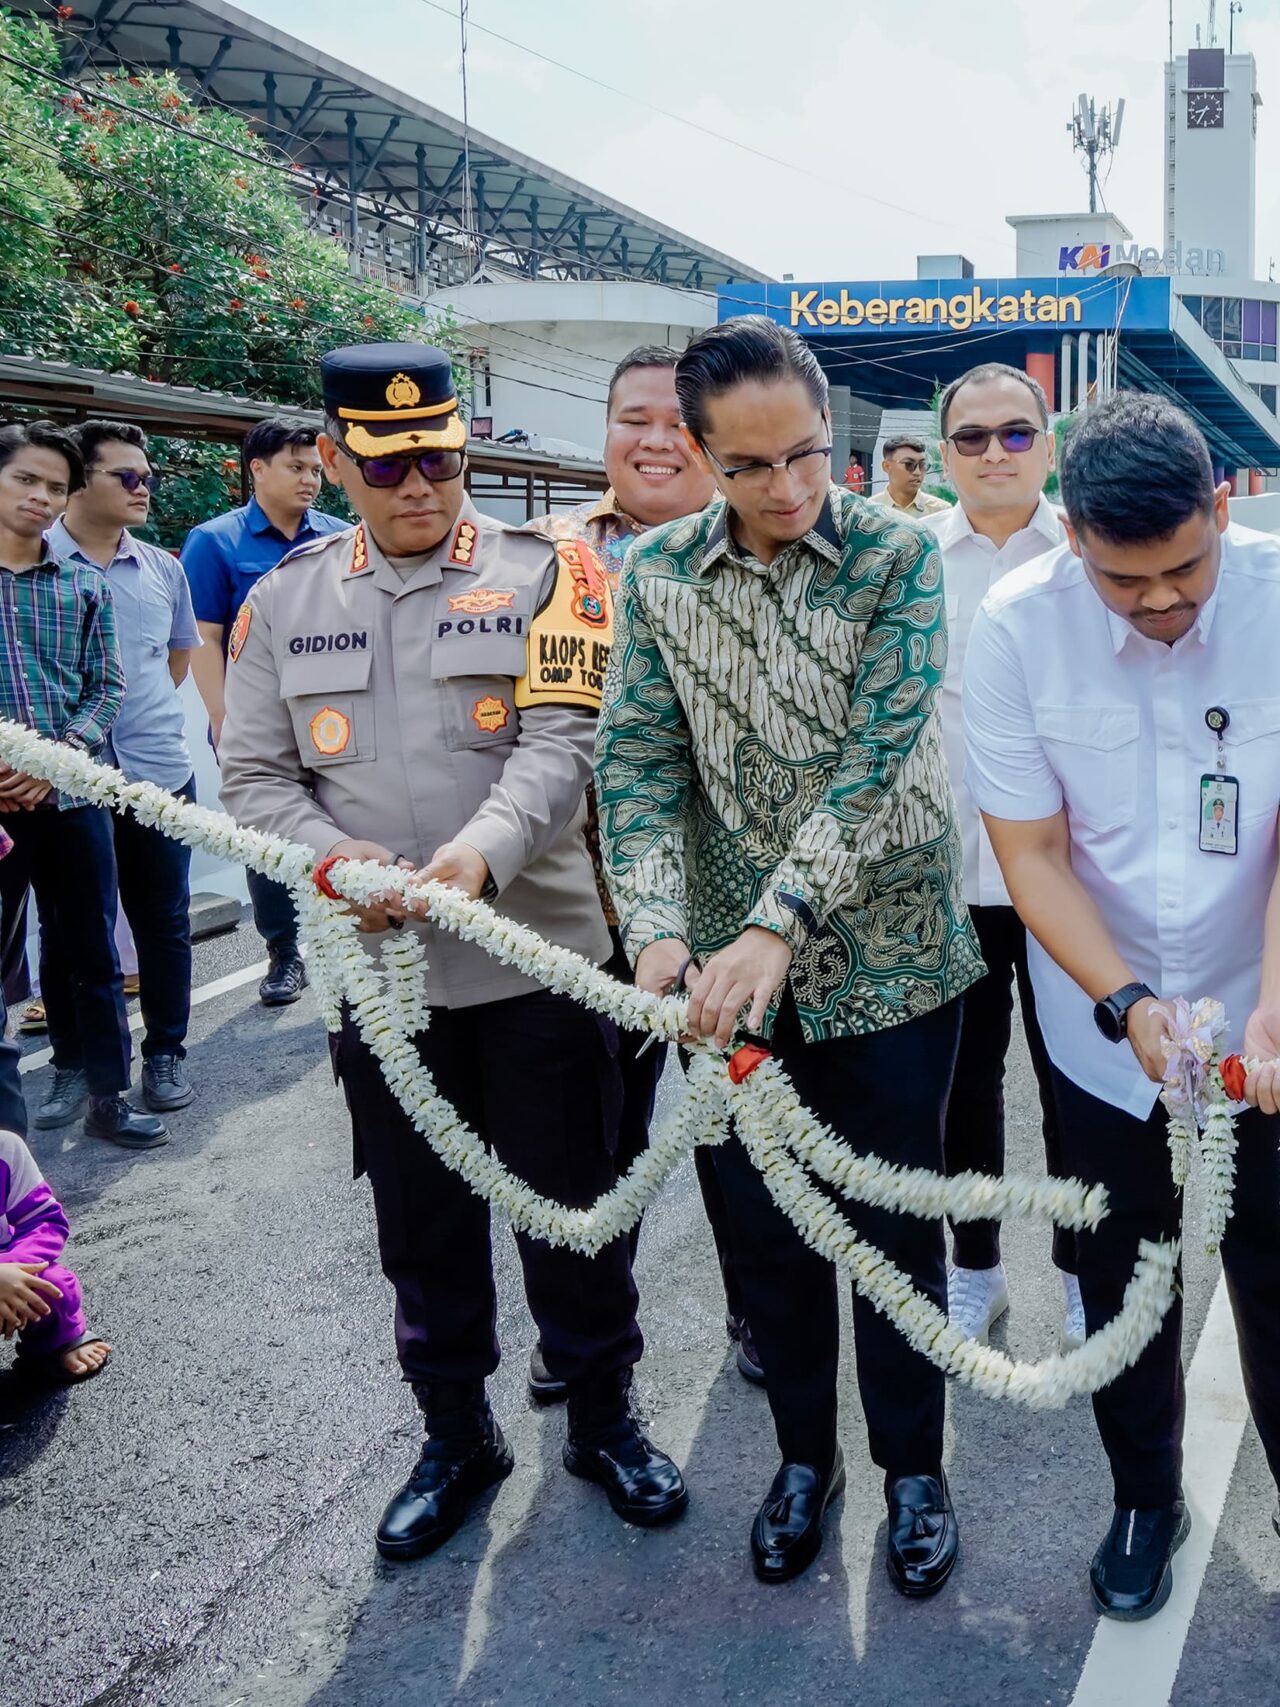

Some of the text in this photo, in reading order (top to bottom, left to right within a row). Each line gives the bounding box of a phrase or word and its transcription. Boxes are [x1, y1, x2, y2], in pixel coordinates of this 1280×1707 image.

[1058, 240, 1227, 272] KAI Medan
[789, 286, 1081, 331] Keberangkatan
[438, 616, 523, 638] POLRI
[289, 631, 367, 655] GIDION
[539, 633, 586, 668] KAOPS
[540, 666, 573, 684] OMP
